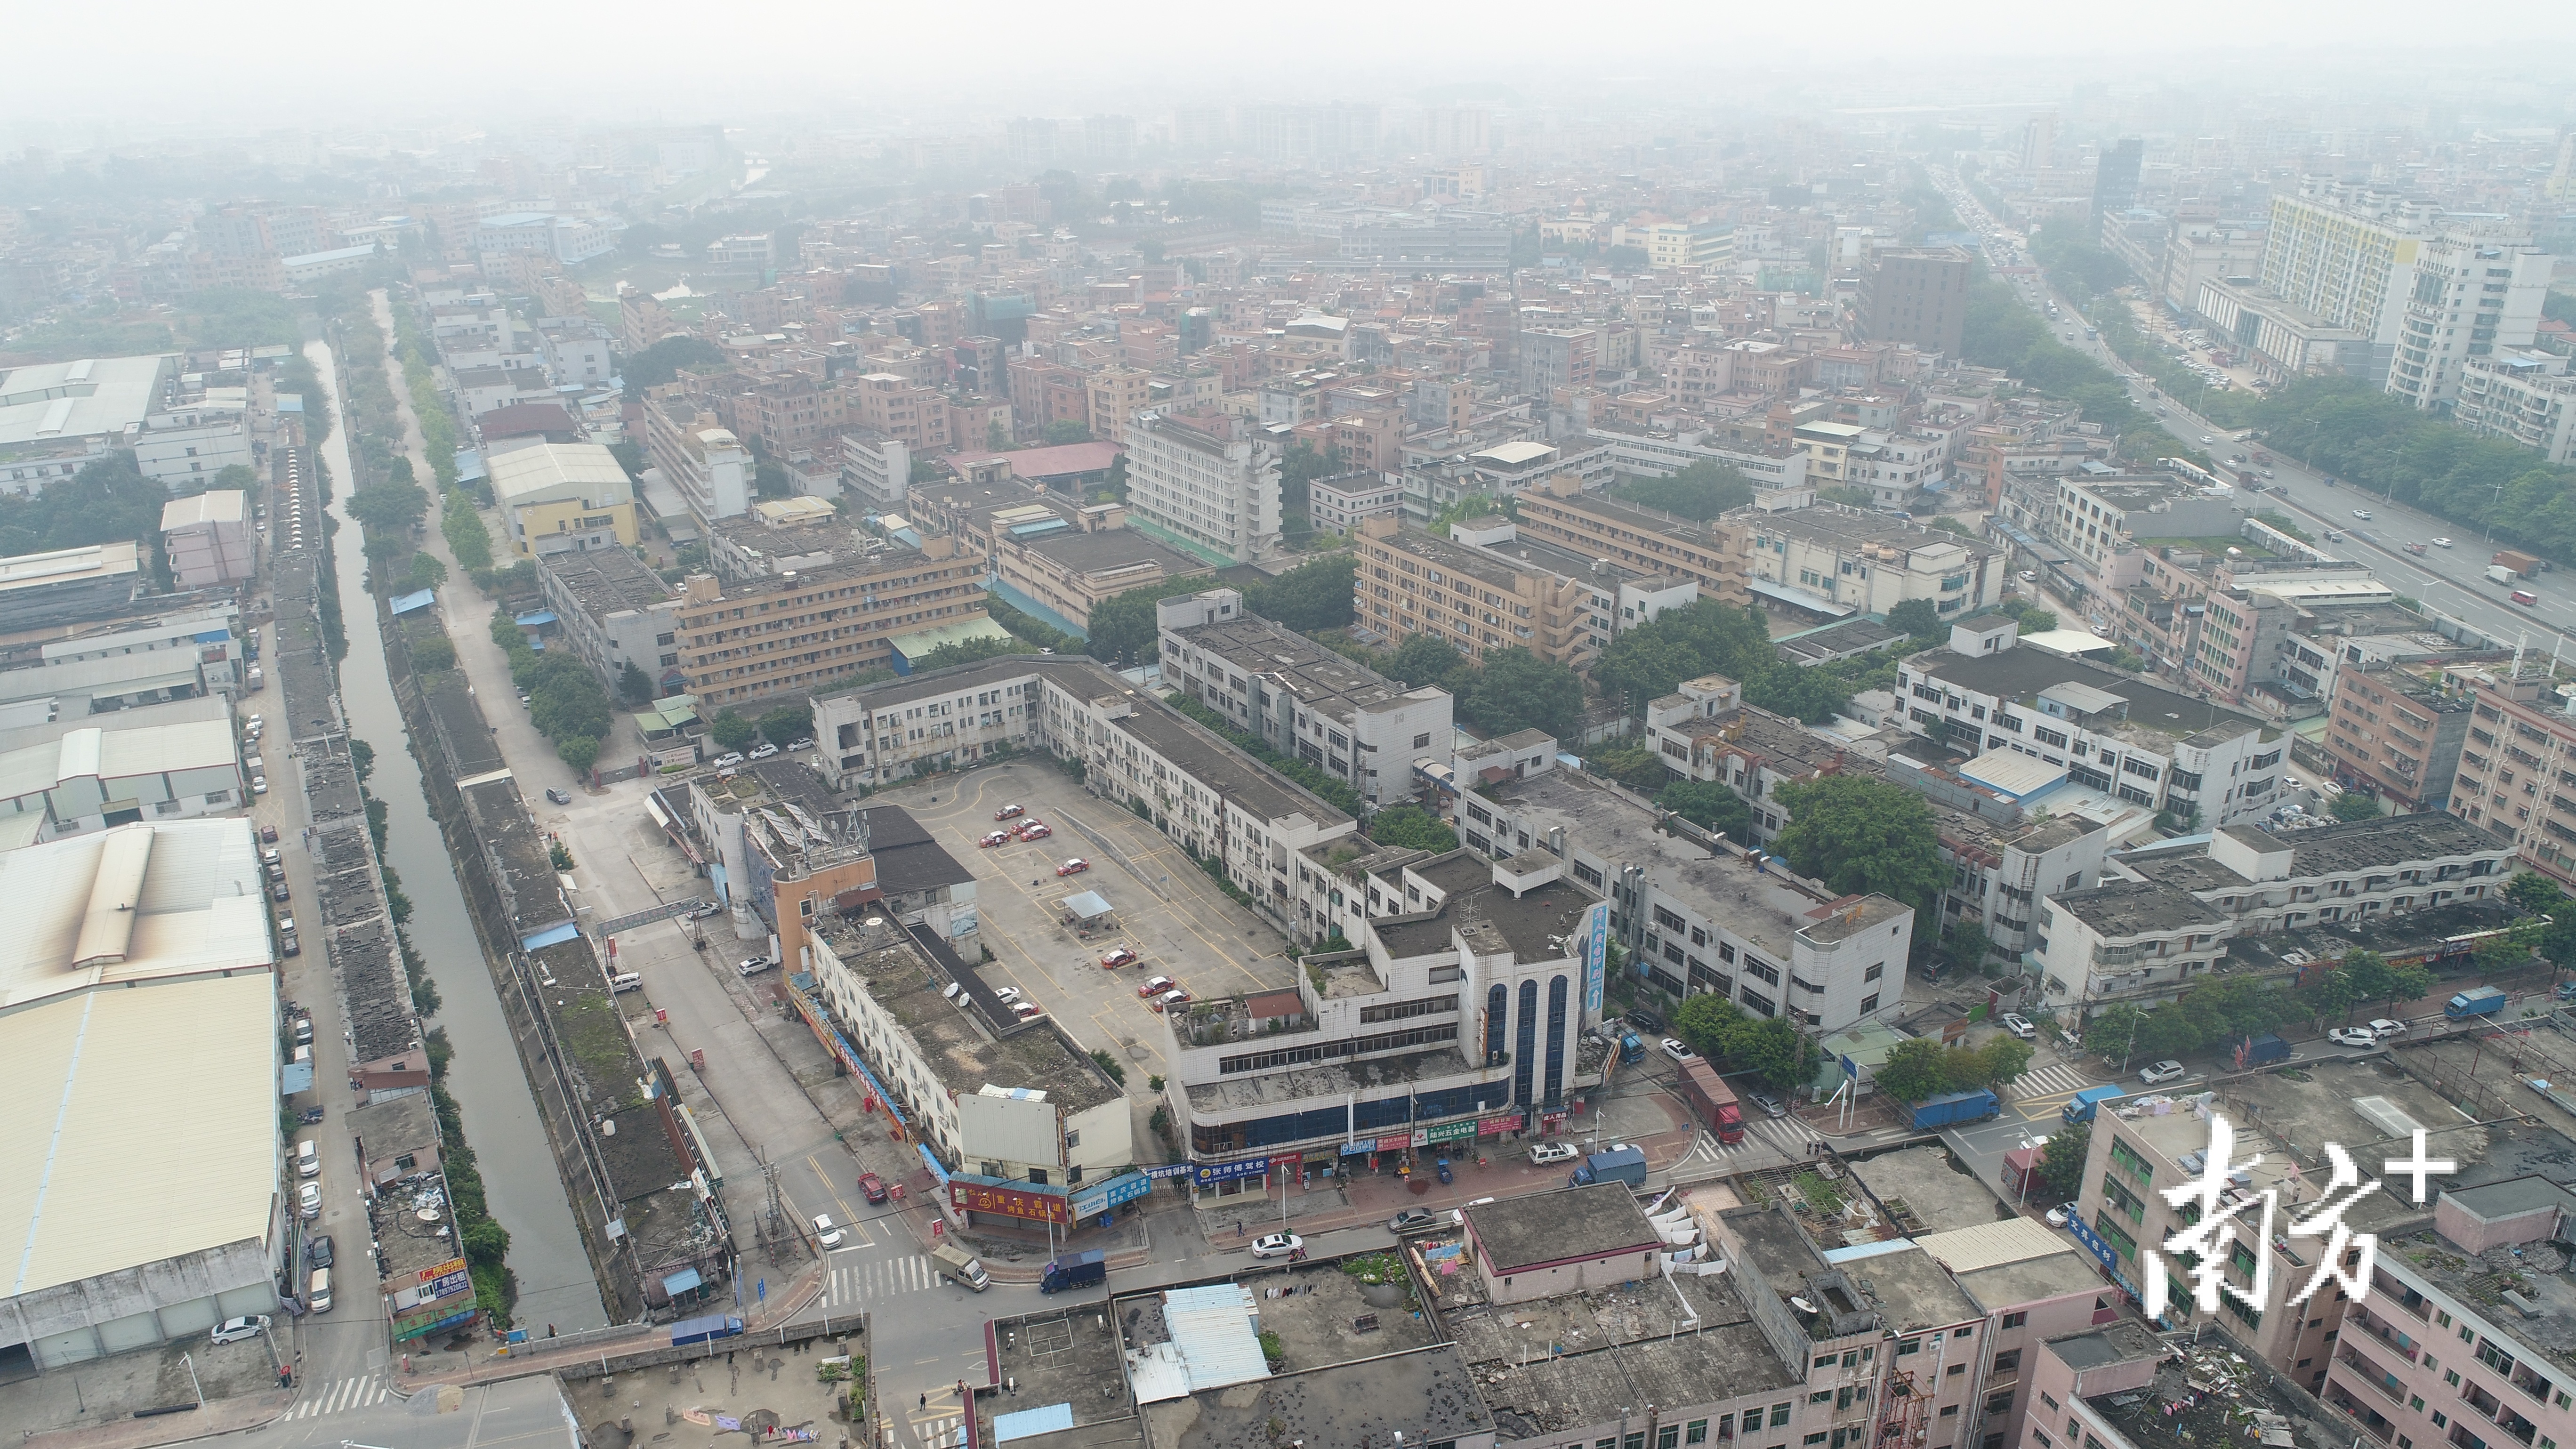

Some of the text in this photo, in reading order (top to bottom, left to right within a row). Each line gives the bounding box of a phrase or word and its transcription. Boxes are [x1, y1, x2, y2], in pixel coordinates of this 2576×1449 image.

[1544, 1112, 1566, 1121] 成人用品
[1430, 1126, 1475, 1139] 陆兴五金电器
[1151, 1165, 1193, 1179] 横坑培训基地
[1212, 1160, 1264, 1176] 张师傅驾校
[997, 1195, 1062, 1212] 重庆霸道
[1079, 1198, 1104, 1212] 江小白
[422, 1258, 465, 1278] 厂房出租
[435, 1272, 466, 1289] 厂房出租
